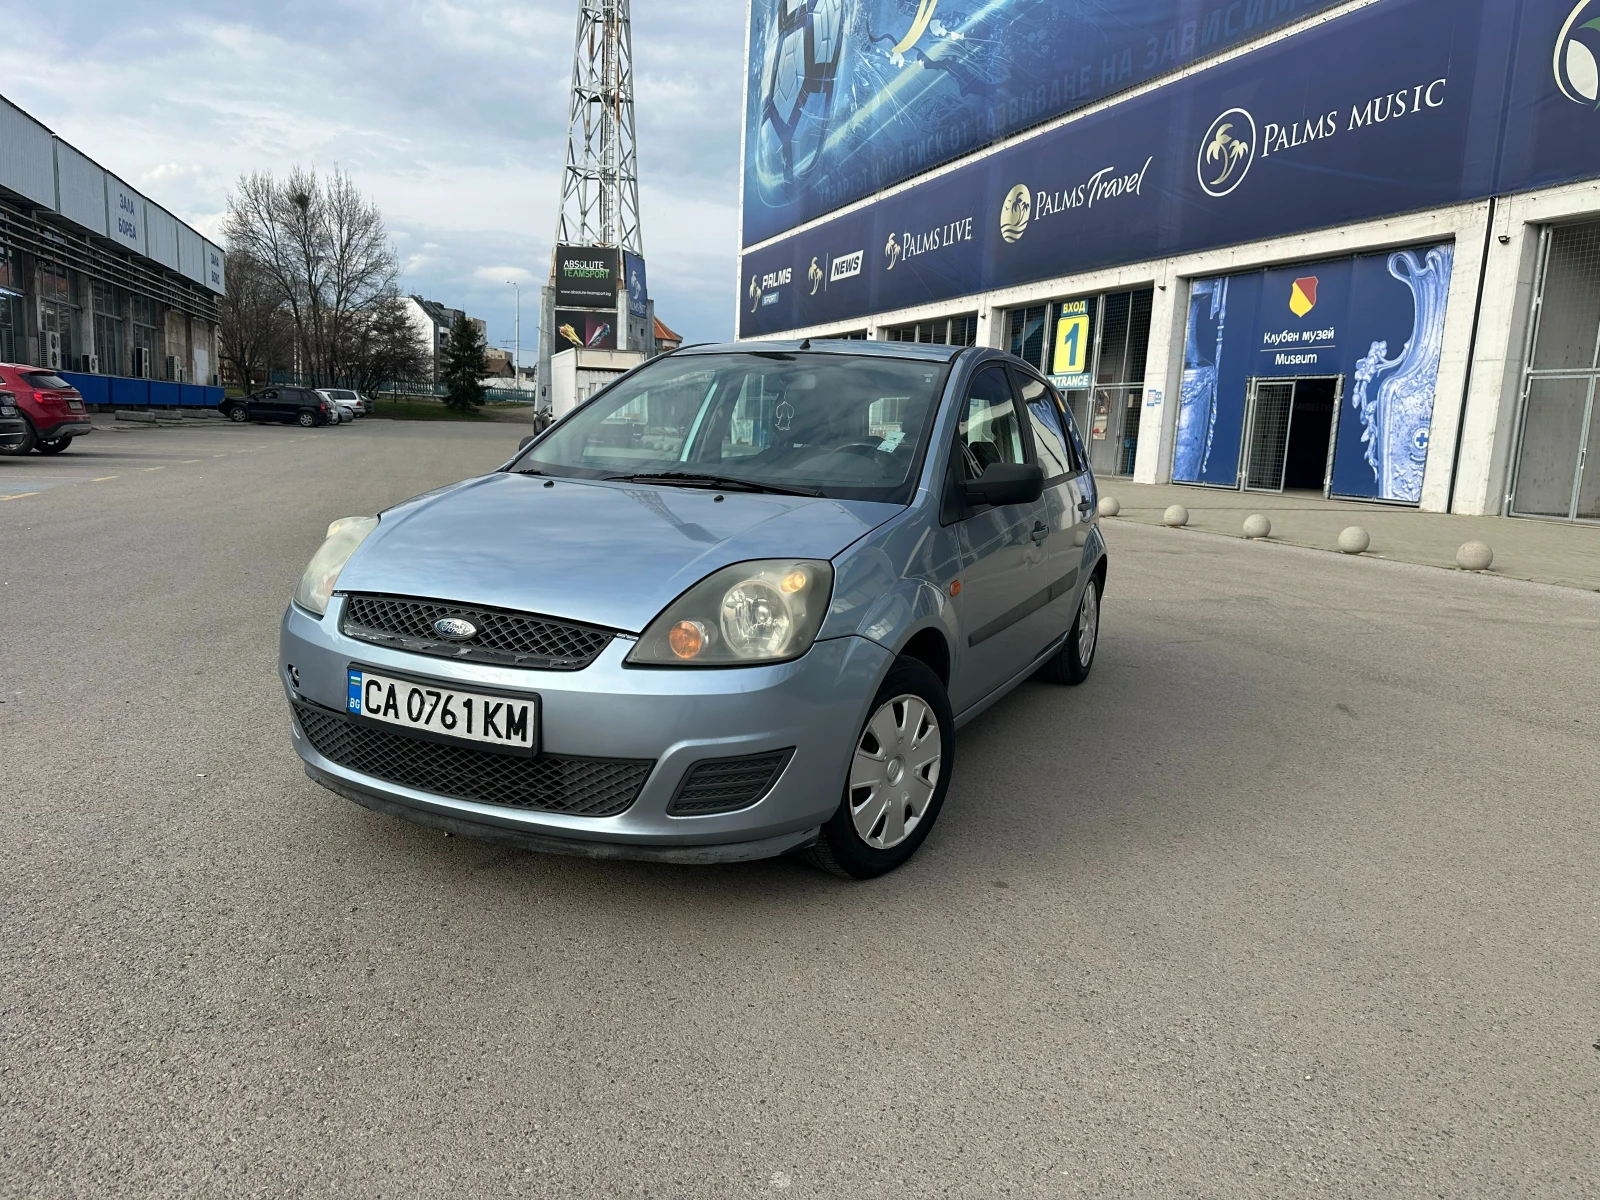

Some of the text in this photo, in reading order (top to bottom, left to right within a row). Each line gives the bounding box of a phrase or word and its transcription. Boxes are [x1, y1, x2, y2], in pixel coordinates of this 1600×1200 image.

[909, 131, 944, 168] РИСК
[976, 65, 1091, 136] РАЗВИВАНЕ
[1101, 49, 1132, 87] НА
[1261, 78, 1446, 158] PALMS MUSIC
[1034, 156, 1153, 221] PALMS Travel
[119, 193, 135, 216] ЗАЛА
[118, 217, 137, 240] БОРБА
[902, 217, 973, 261] PALMS LIVE
[563, 260, 604, 269] ABSOLUTE
[564, 269, 610, 279] TEAMSPORT
[833, 255, 860, 277] NEWS
[762, 267, 792, 290] PALMS
[560, 289, 612, 297] www.absolute-teamsport.bg
[763, 293, 777, 304] SPORT
[1063, 300, 1086, 314] ВХОД
[1064, 322, 1080, 367] 1
[1263, 327, 1335, 345] Клубен музей
[1275, 353, 1317, 365] Museum
[441, 621, 465, 634] Ford
[349, 679, 529, 743] BG CA 0761 KM
